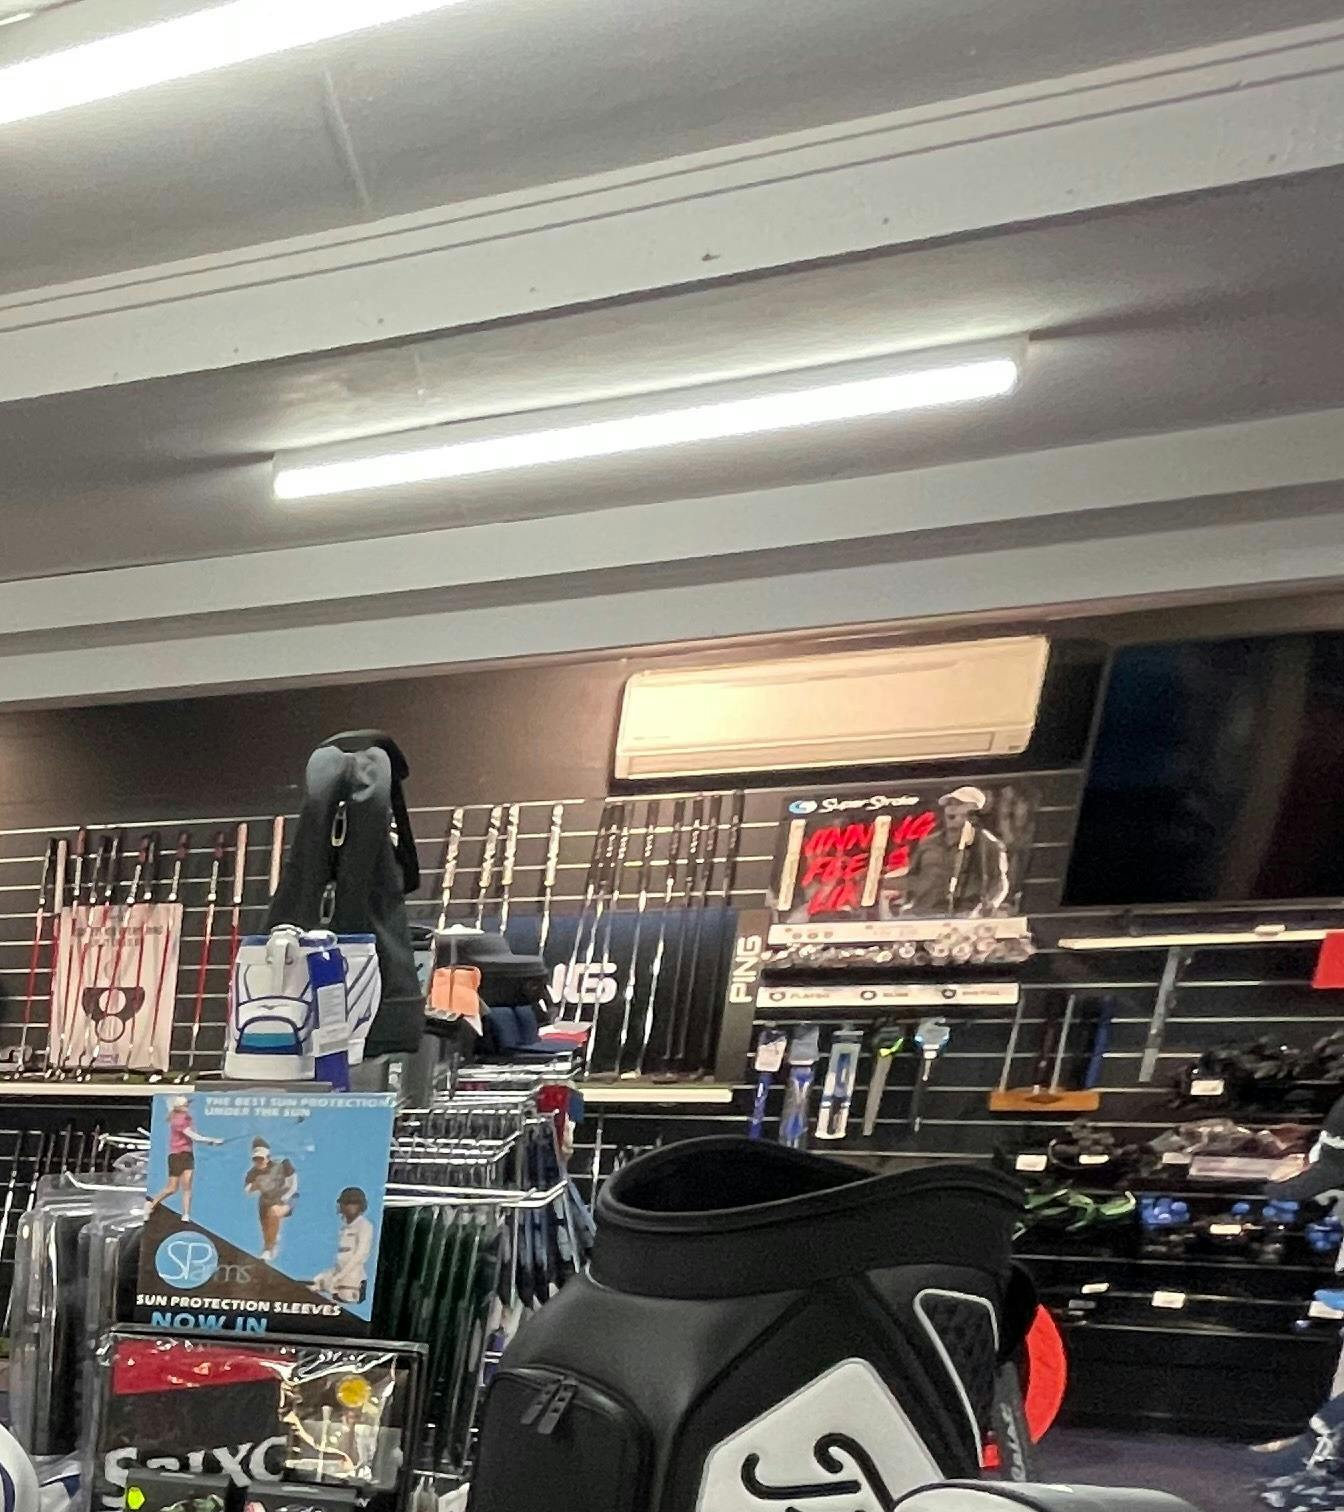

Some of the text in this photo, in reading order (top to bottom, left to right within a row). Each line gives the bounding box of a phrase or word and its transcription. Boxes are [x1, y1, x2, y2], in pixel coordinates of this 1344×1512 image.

[729, 935, 761, 1003] PING
[136, 1294, 341, 1316] SUN PROTECTION SLEEVES
[151, 1311, 223, 1330] NOW
